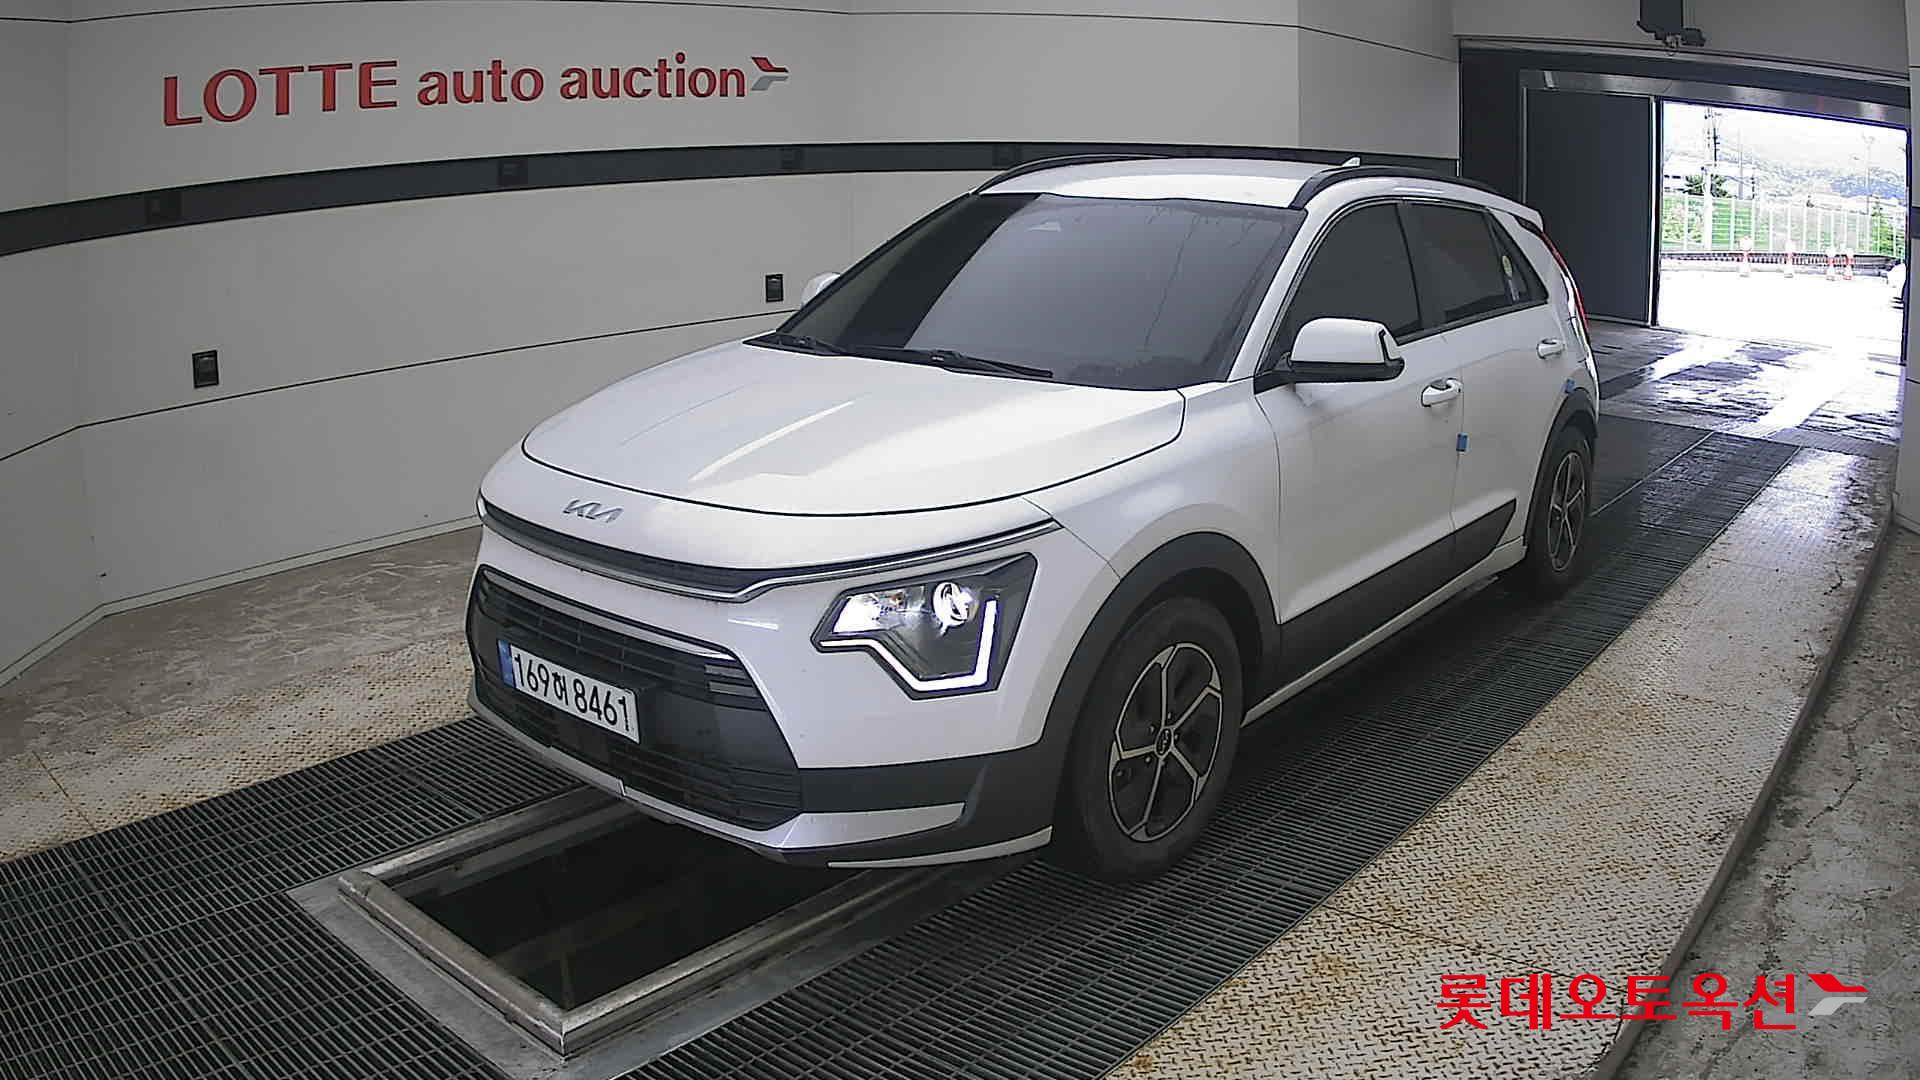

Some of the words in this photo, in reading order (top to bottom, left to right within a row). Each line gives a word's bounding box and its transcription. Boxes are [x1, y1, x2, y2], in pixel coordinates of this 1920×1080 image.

[162, 60, 398, 127] LOTTE
[416, 59, 543, 107] auto
[559, 52, 746, 99] auction
